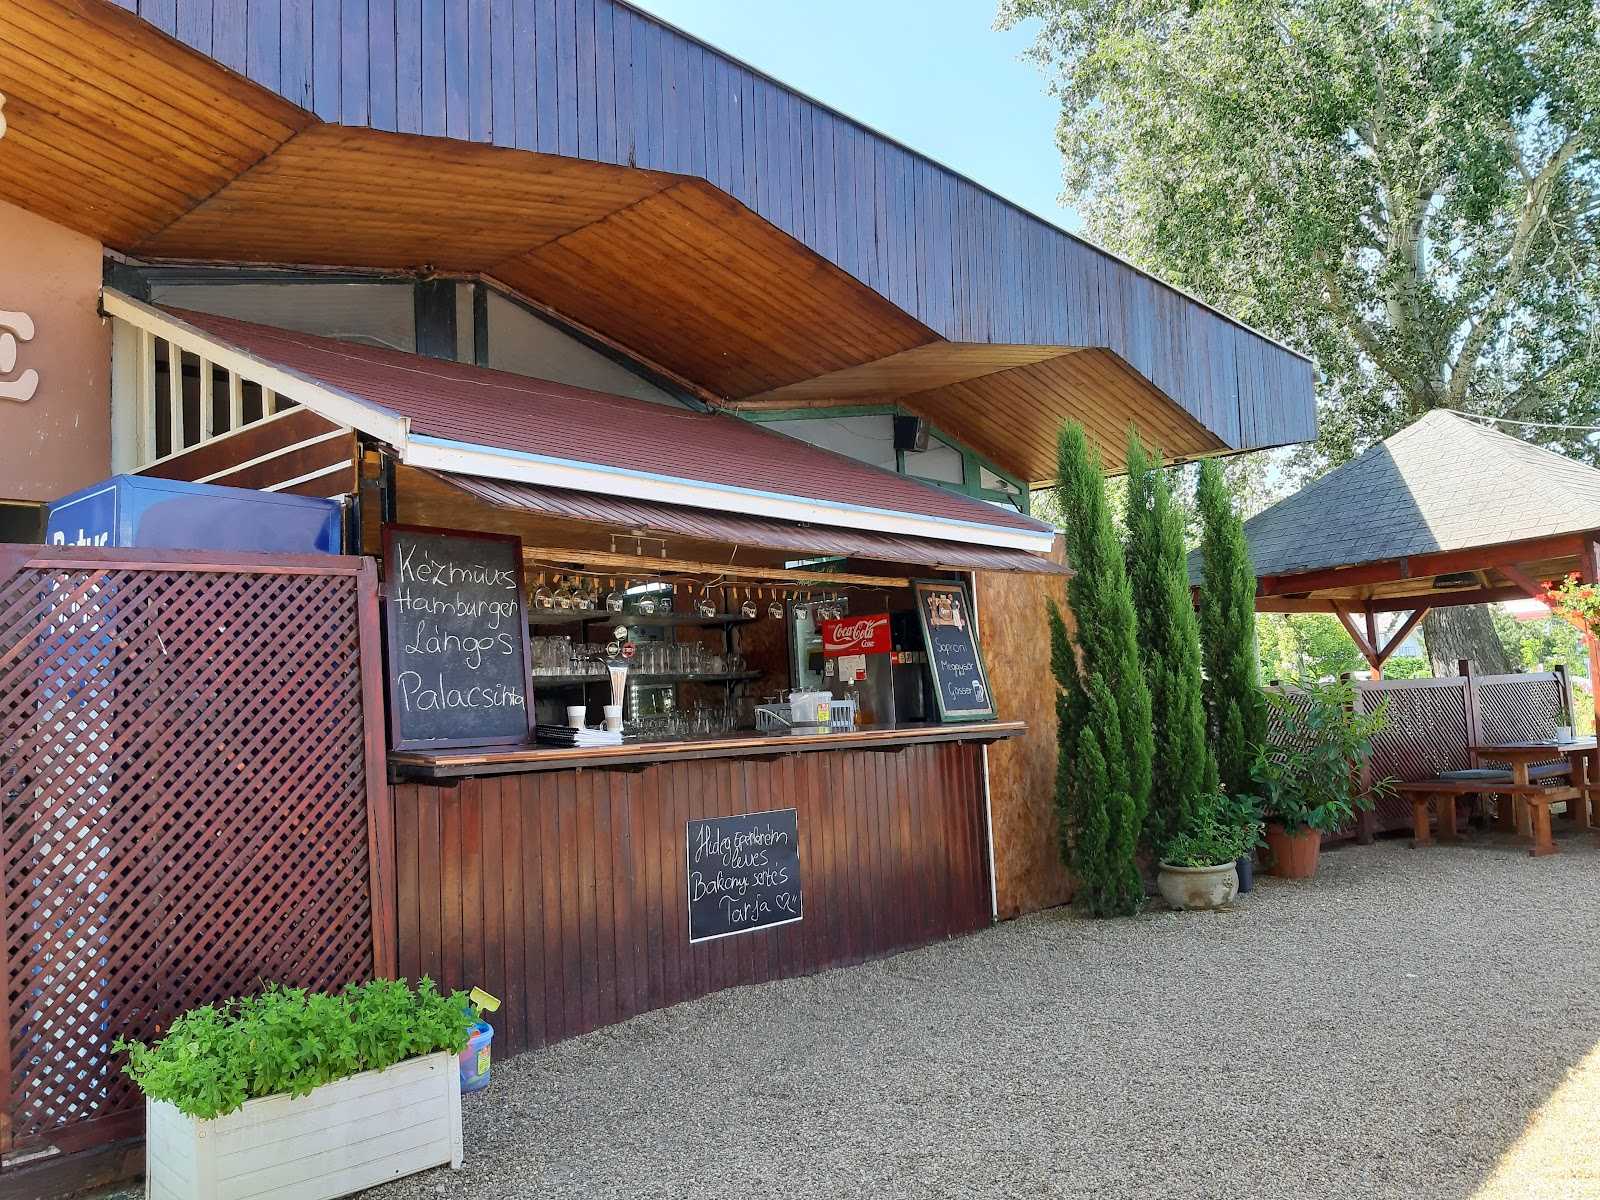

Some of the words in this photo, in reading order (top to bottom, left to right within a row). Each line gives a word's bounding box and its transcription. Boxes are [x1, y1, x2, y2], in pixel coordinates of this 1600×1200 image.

[405, 619, 513, 669] Lángos
[397, 670, 526, 712] Palacsinta
[718, 893, 772, 926] Tarja
